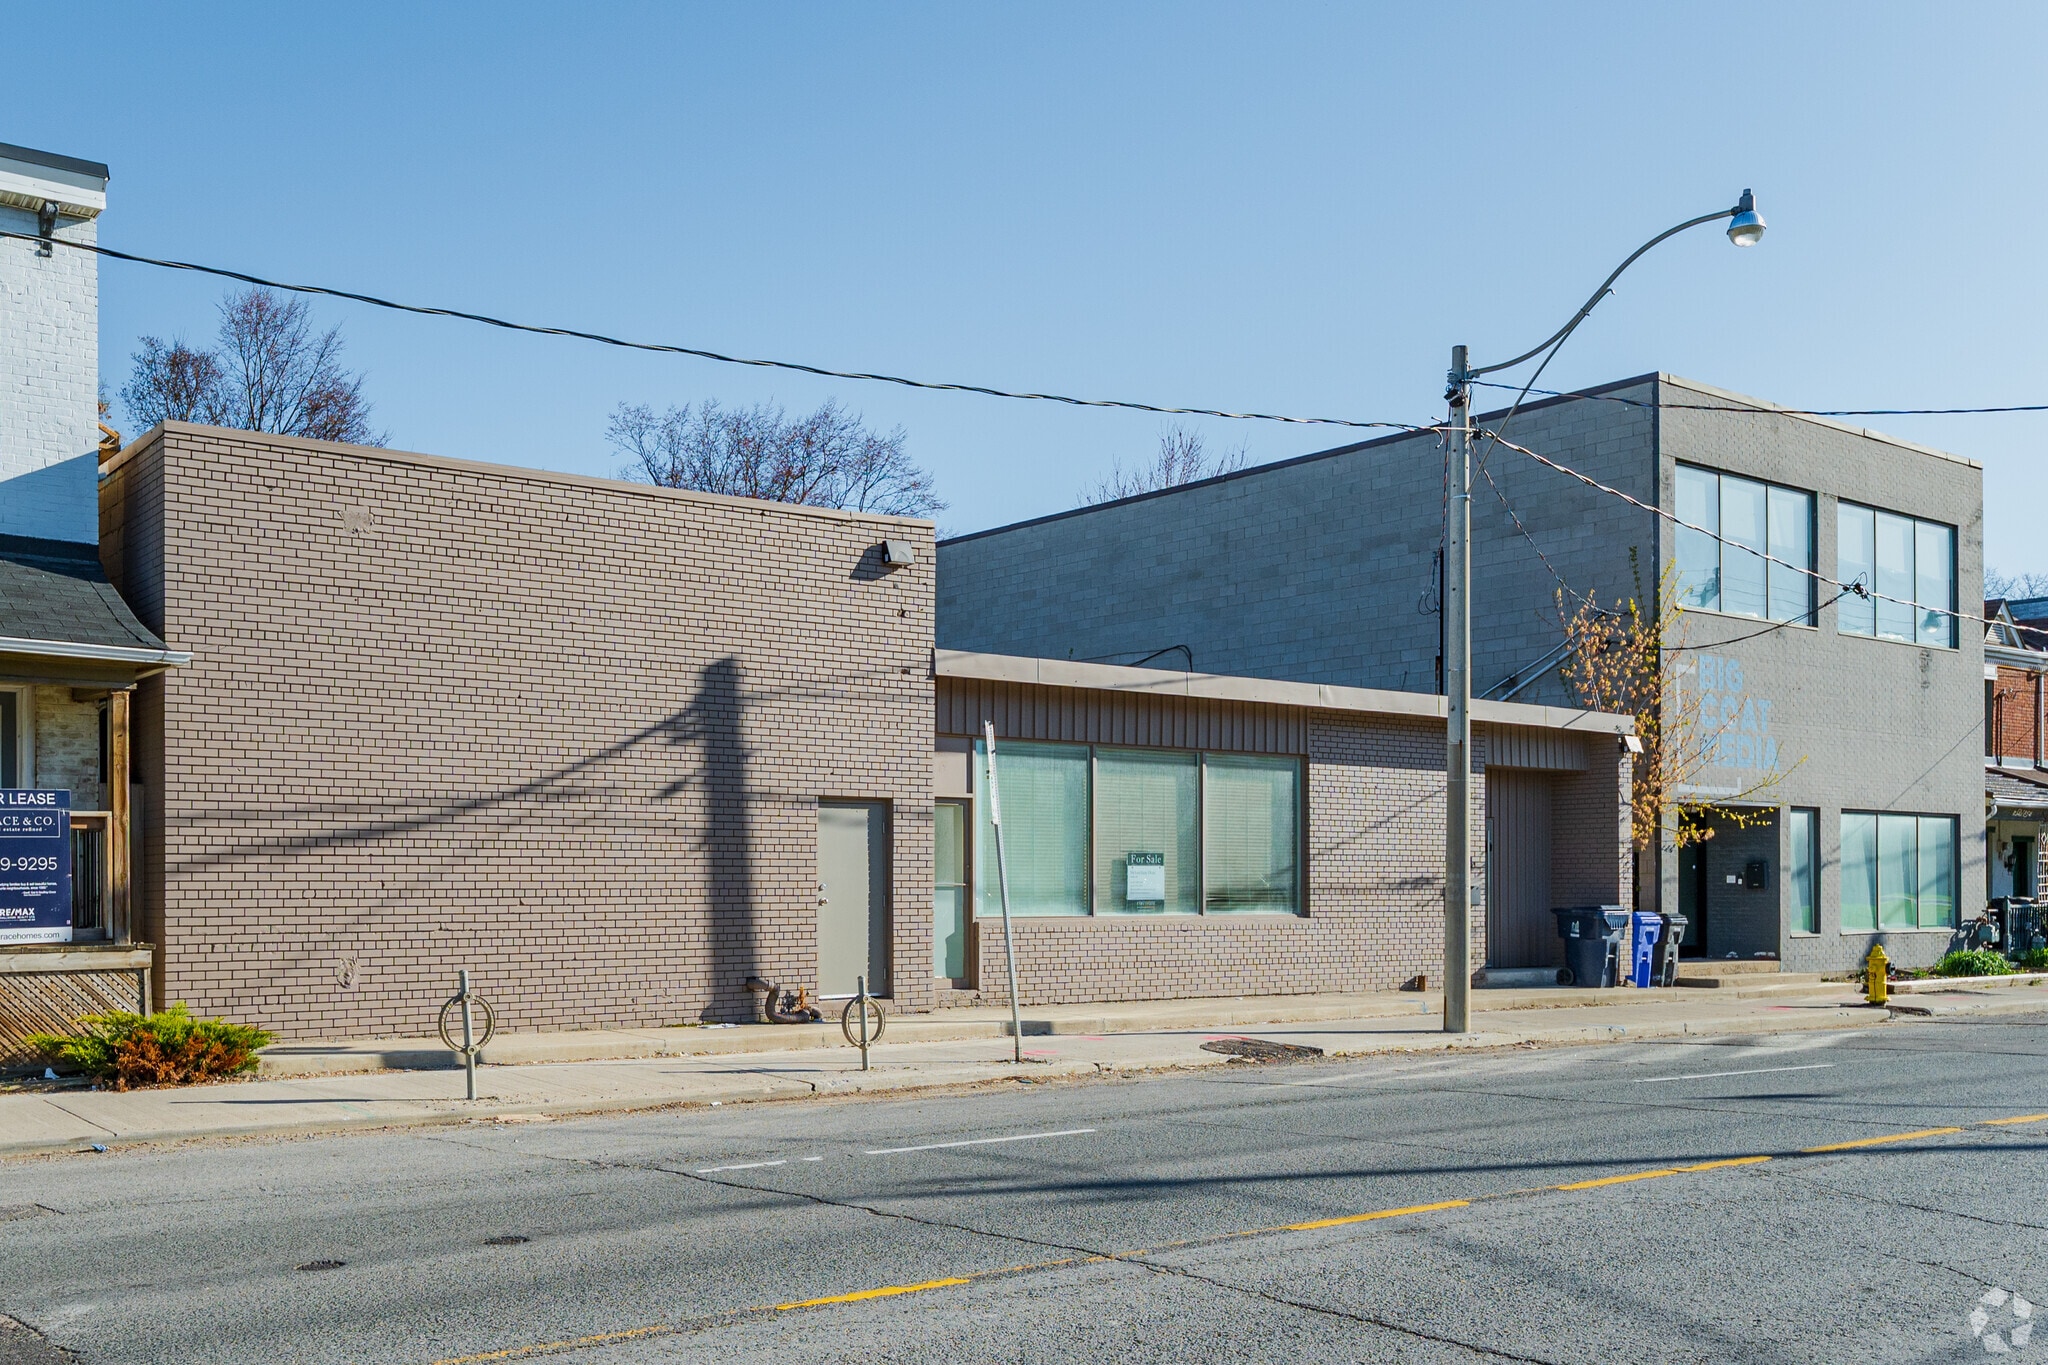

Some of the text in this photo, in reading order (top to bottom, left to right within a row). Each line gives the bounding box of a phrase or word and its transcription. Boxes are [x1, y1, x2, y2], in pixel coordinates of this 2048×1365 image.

[1699, 654, 1743, 692] BIG
[1700, 693, 1772, 734] COAT
[1700, 730, 1780, 771] MEDIA
[9, 792, 56, 805] LEASE
[22, 816, 32, 826] &
[34, 816, 56, 826] CO.
[1131, 854, 1162, 864] For Sale
[0, 907, 35, 917] RE/MAX
